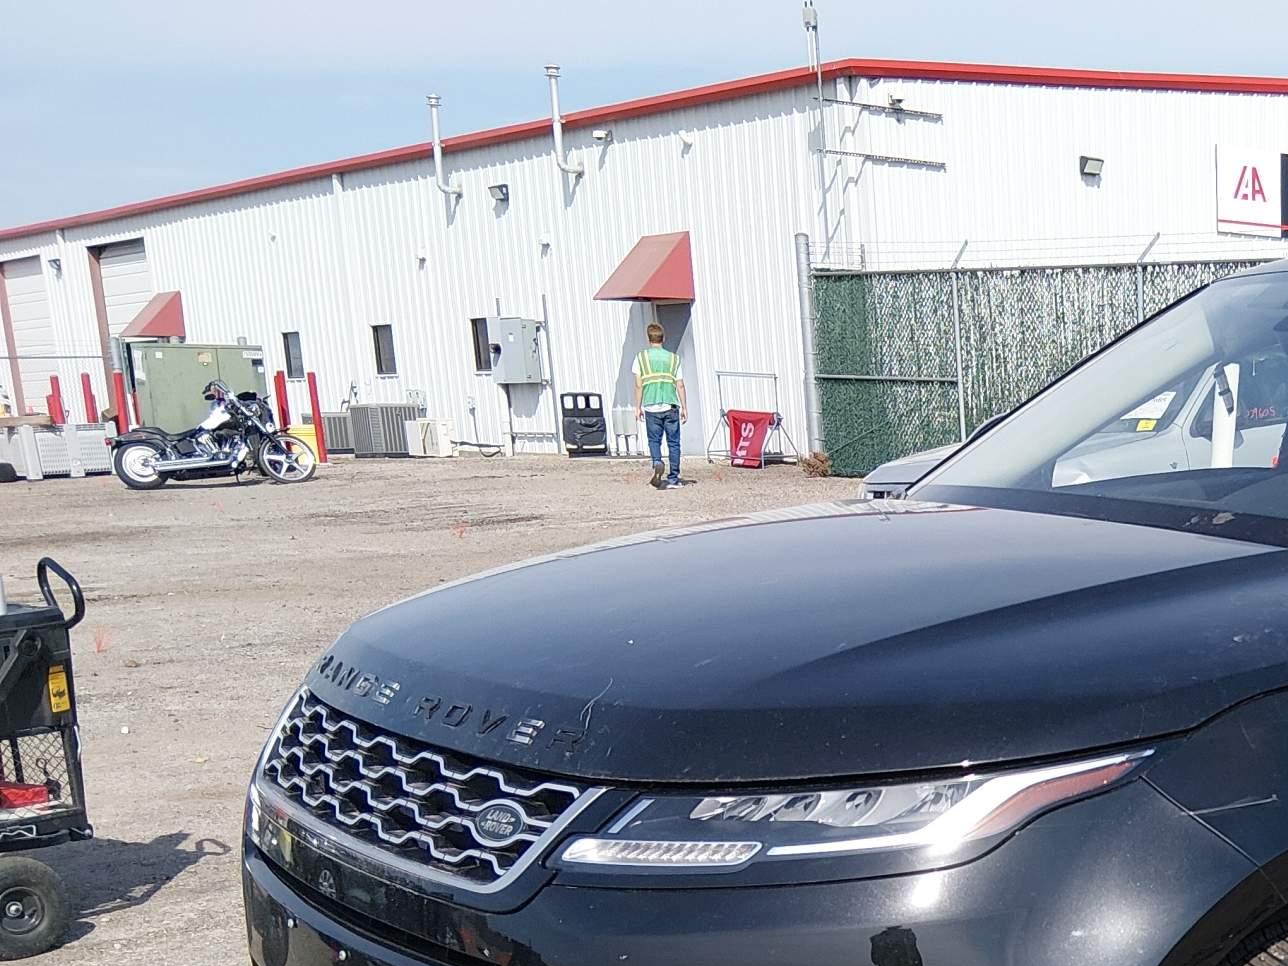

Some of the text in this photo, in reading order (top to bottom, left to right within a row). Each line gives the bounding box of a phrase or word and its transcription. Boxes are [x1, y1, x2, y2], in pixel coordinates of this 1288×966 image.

[317, 655, 589, 752] RANGE ROVER
[486, 810, 512, 823] LAND
[484, 820, 514, 836] ROVER
